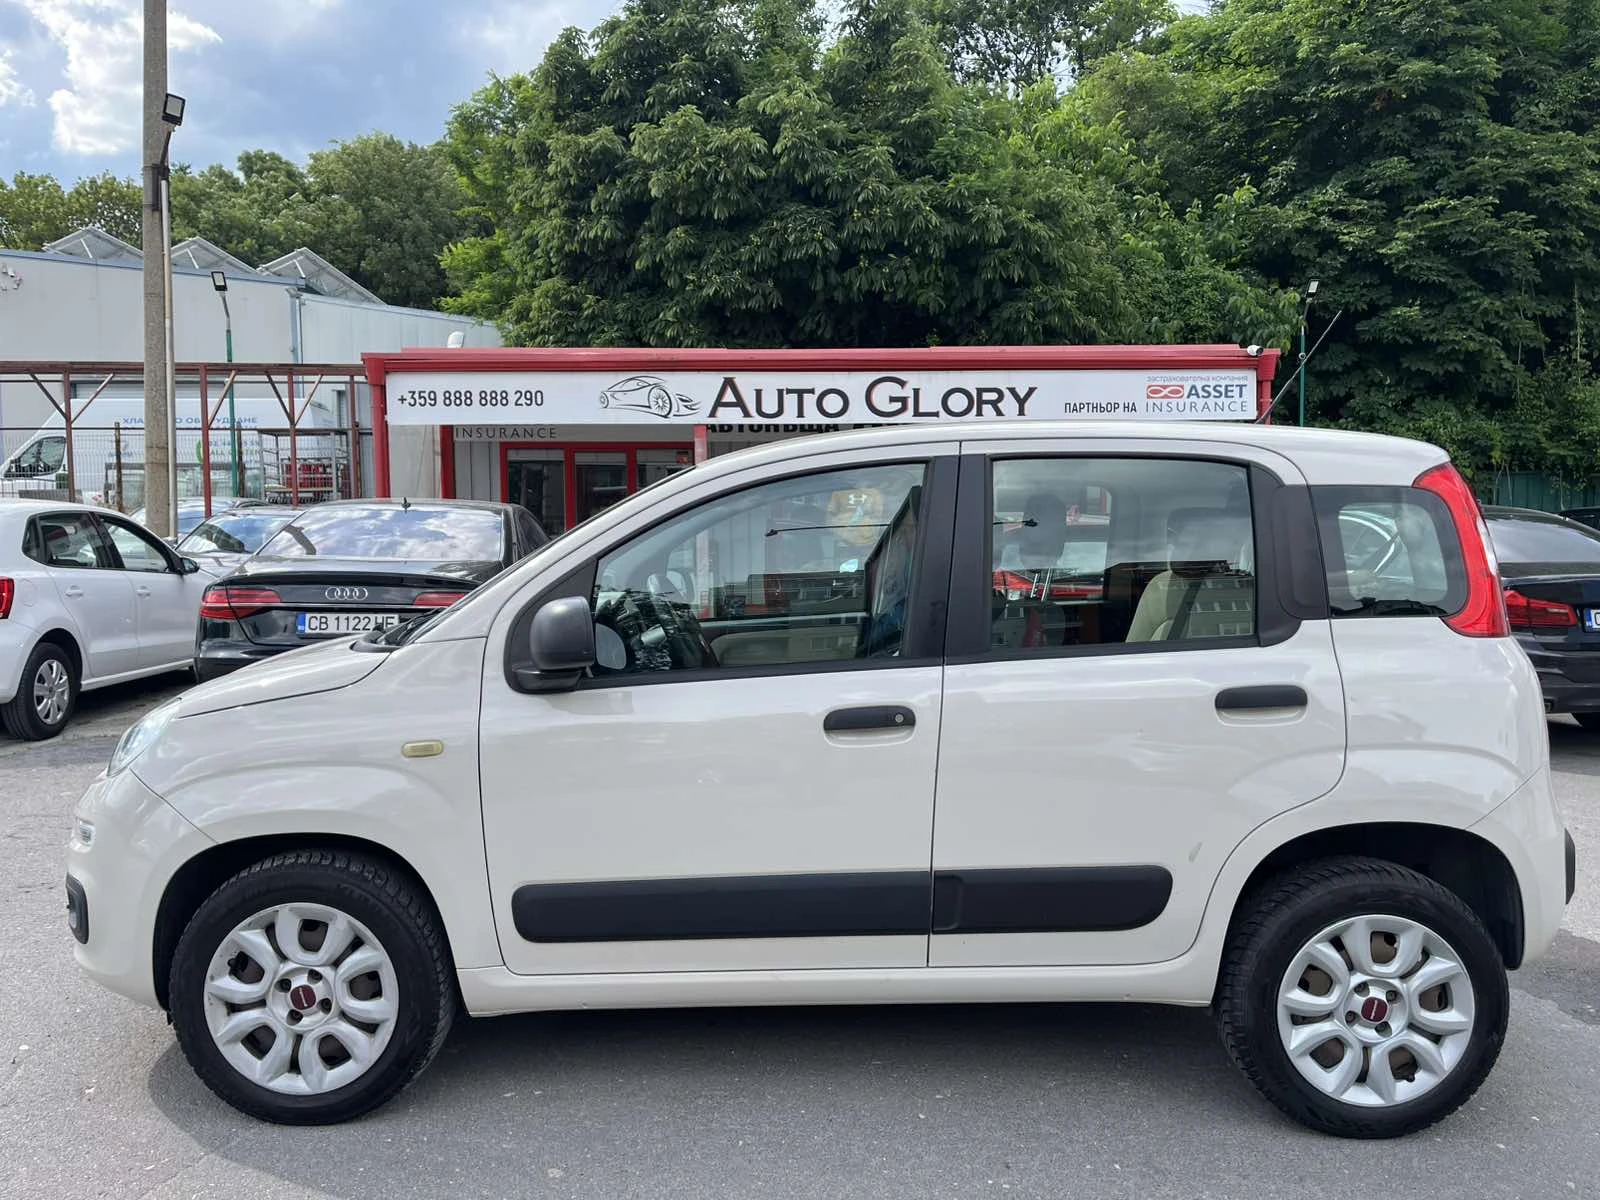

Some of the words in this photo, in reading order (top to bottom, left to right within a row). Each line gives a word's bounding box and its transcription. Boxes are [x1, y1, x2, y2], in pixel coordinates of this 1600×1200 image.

[398, 390, 437, 407] +359
[443, 390, 473, 407] 888
[479, 390, 509, 407] 888
[514, 390, 544, 407] 290
[707, 376, 850, 419] AUTO
[865, 376, 1038, 418] GLORY
[1186, 384, 1248, 399] ASSET
[1064, 402, 1120, 414] ПАРТНЬОР
[1123, 402, 1137, 413] НА
[1146, 401, 1248, 413] INSURANCE
[455, 427, 557, 439] INSURANCE
[308, 615, 329, 631] CB
[334, 615, 371, 631] 1122
